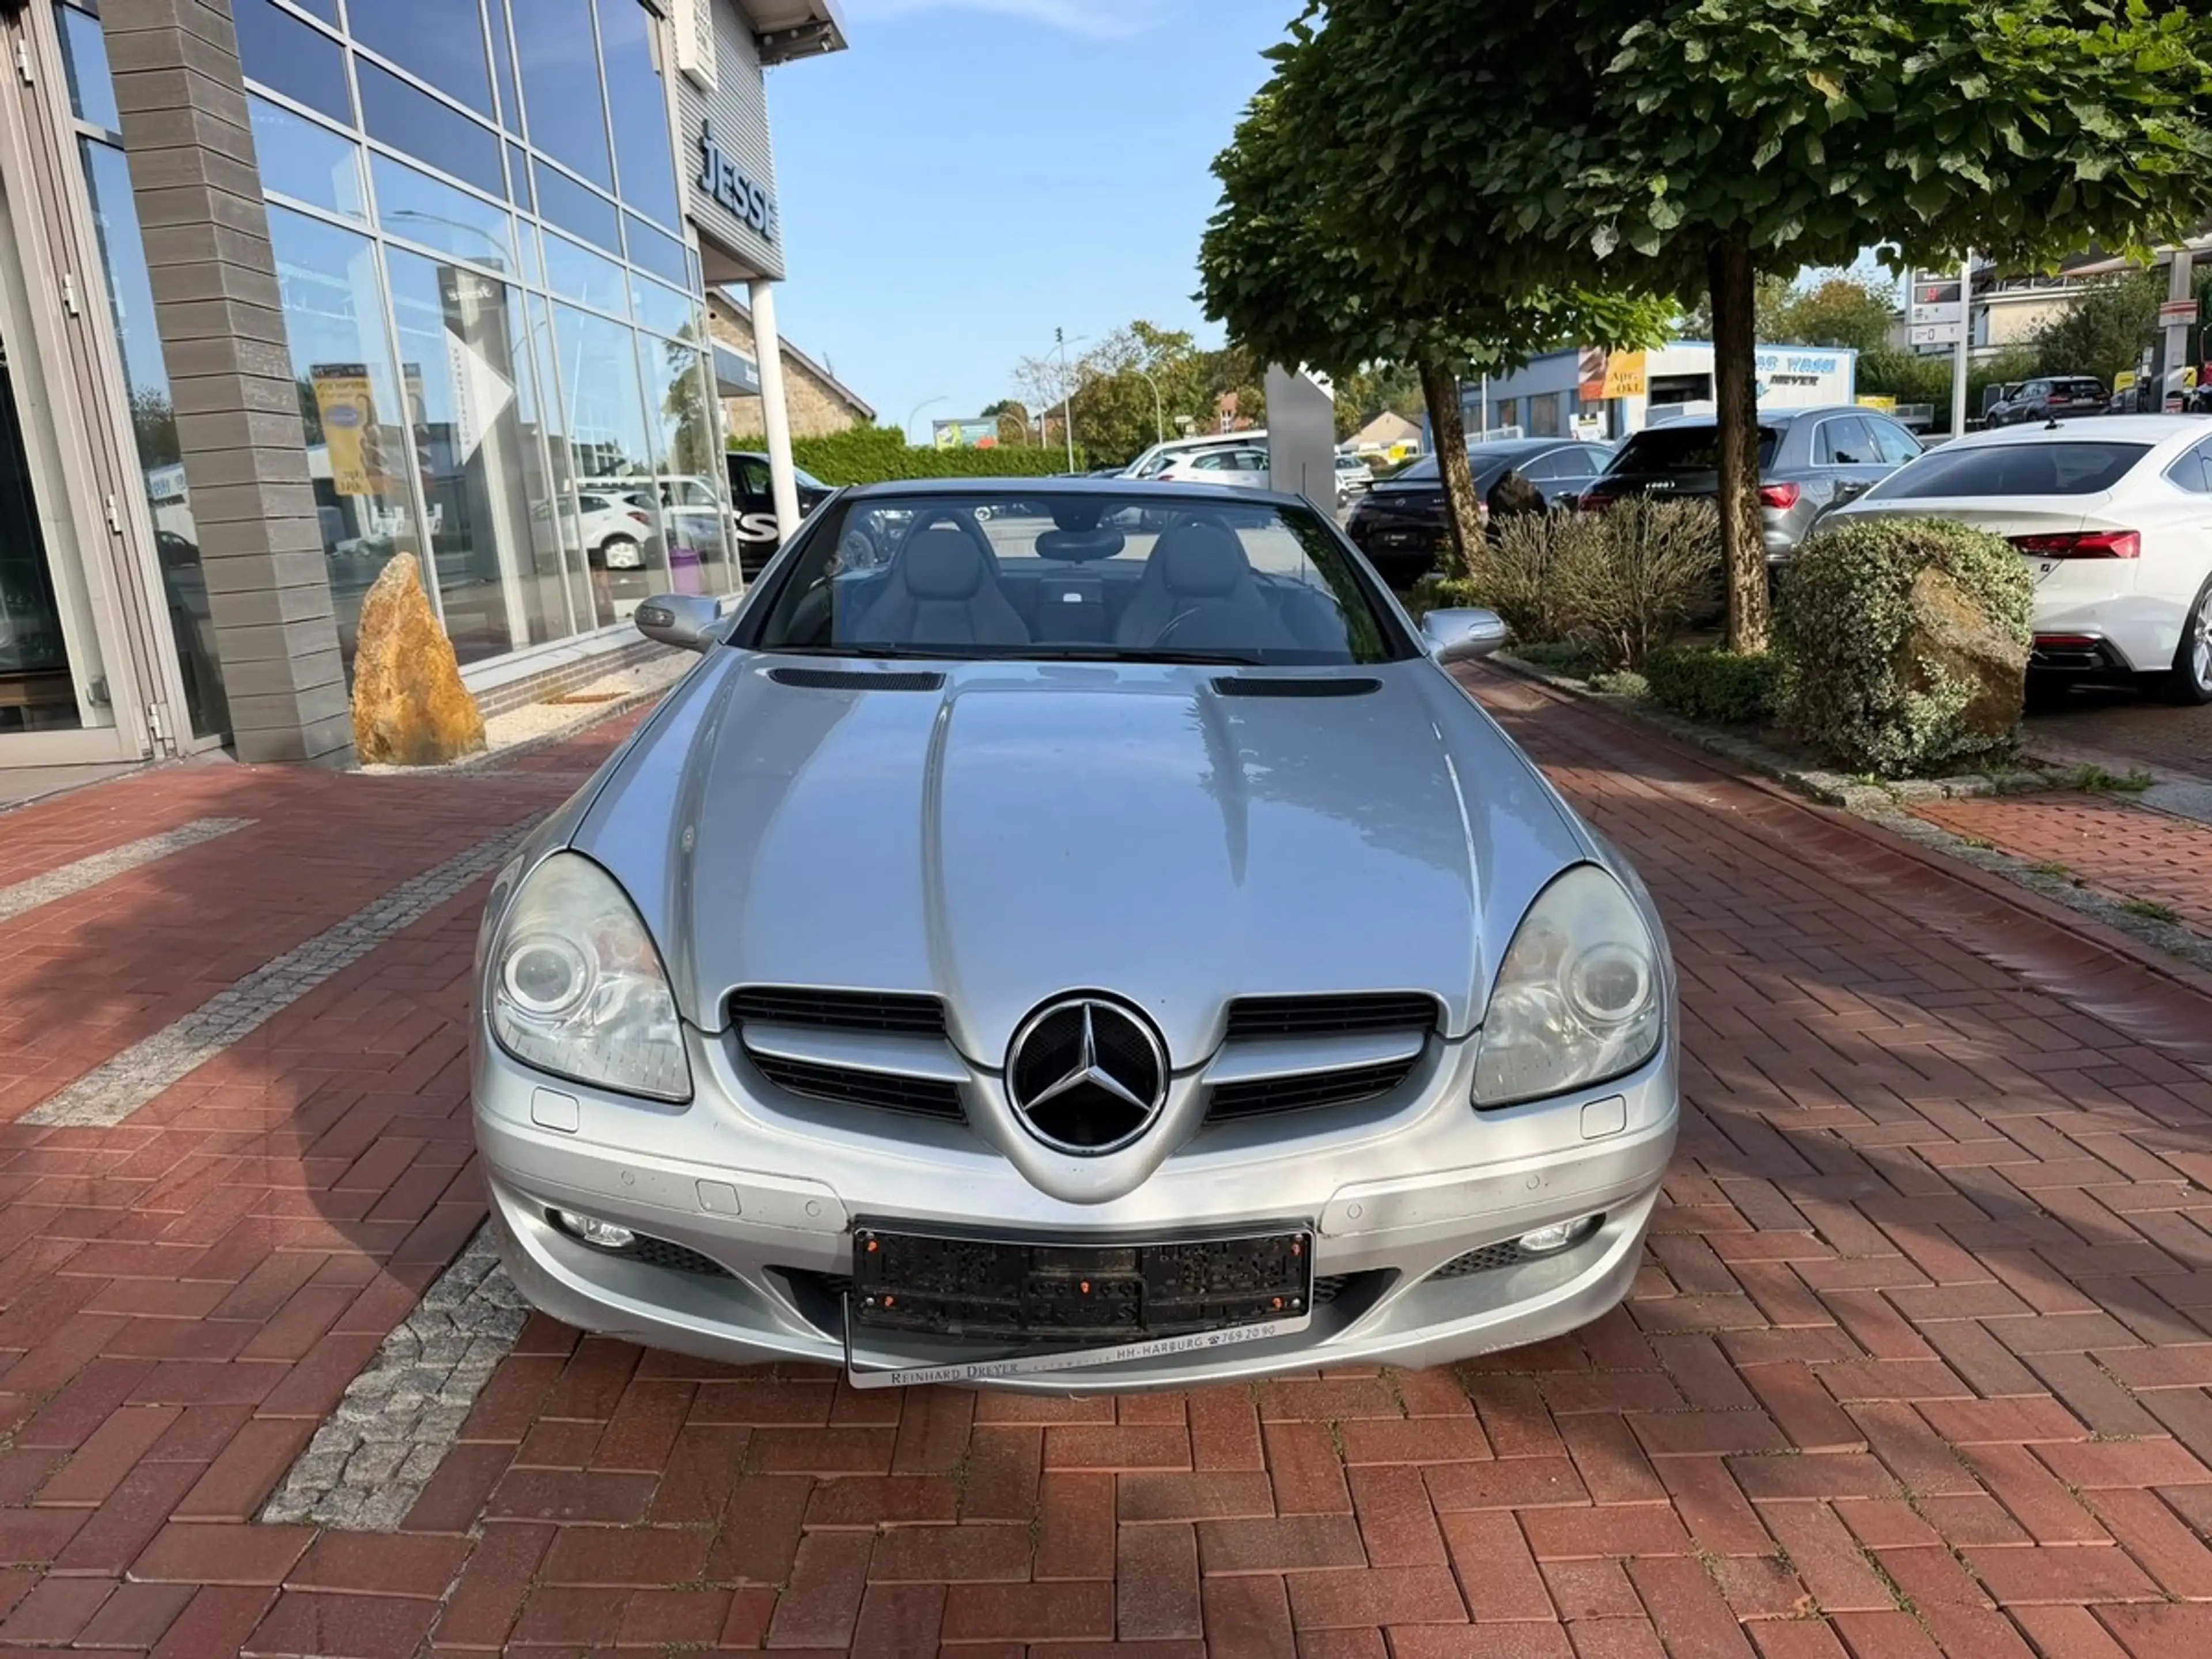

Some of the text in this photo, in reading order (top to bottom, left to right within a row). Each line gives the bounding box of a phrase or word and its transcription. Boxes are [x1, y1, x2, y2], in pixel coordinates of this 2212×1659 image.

[891, 1369, 960, 1384] REINHARD
[967, 1363, 1018, 1378] DREYER
[1117, 1337, 1202, 1359] HH-HARBURG
